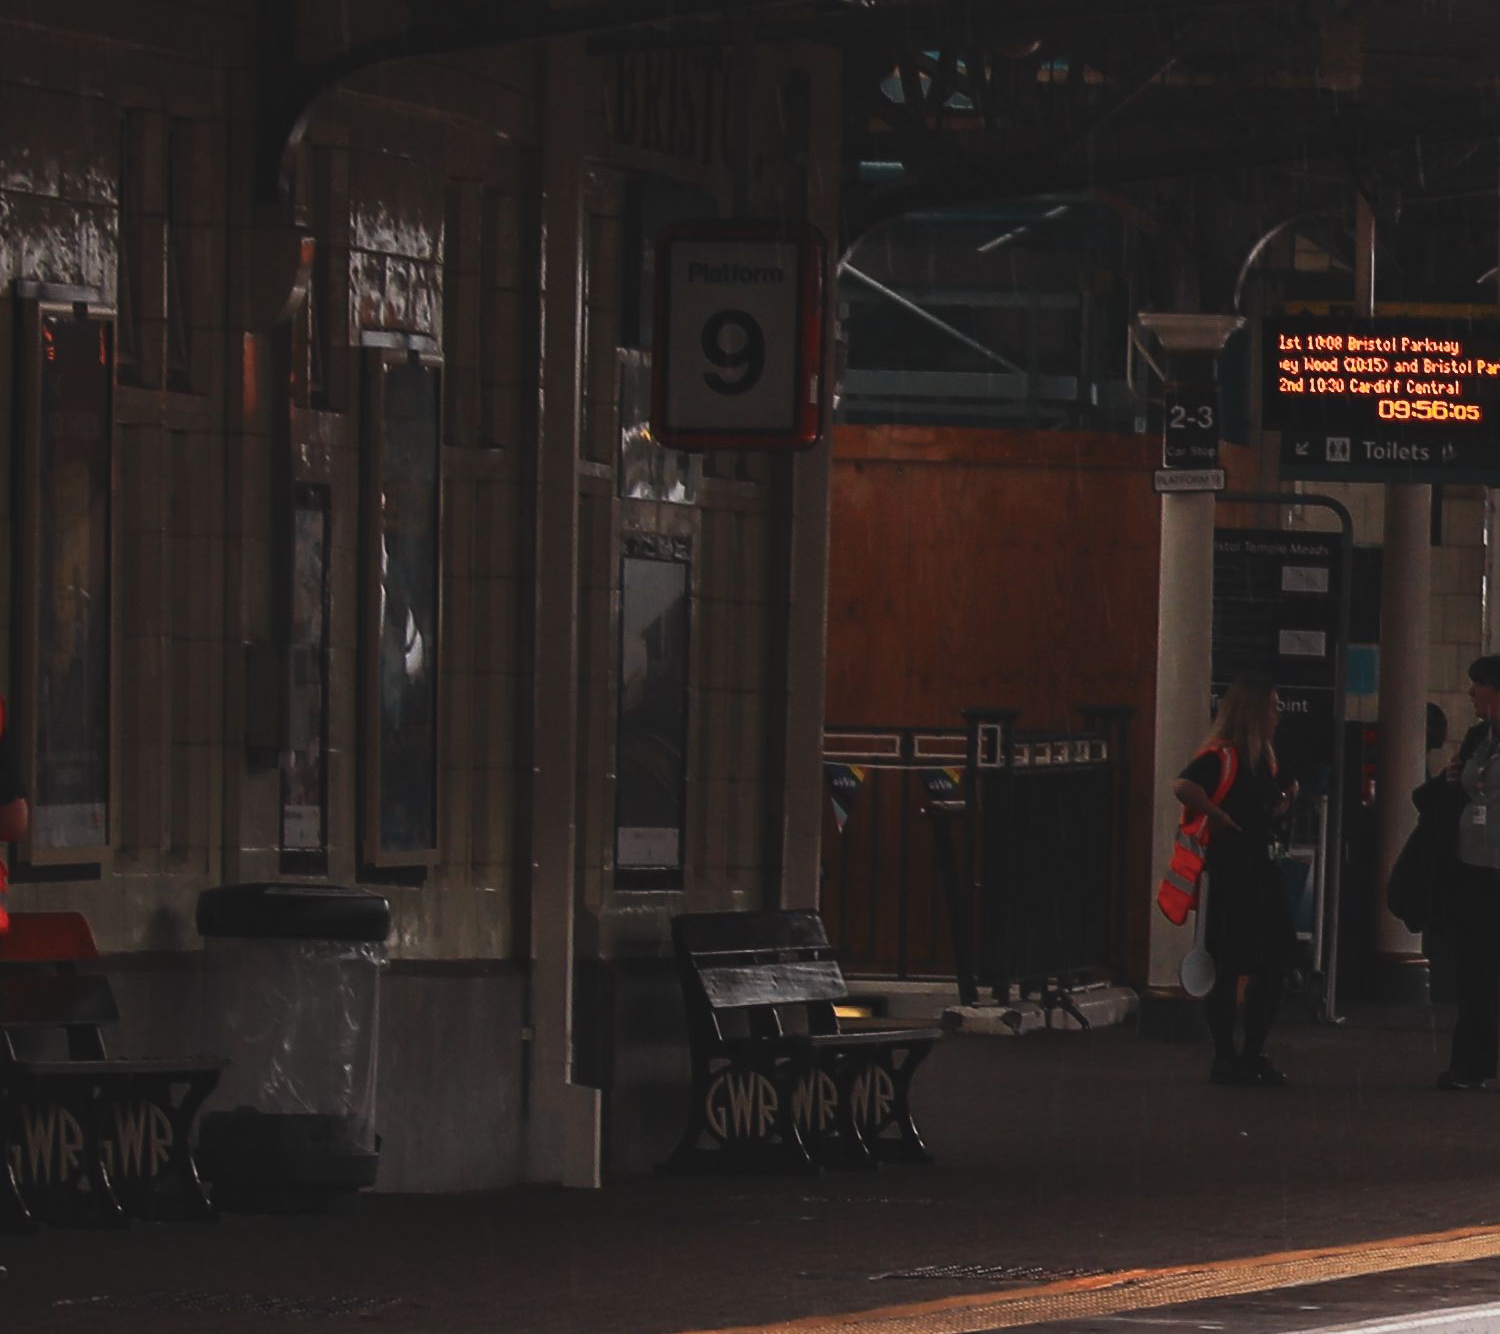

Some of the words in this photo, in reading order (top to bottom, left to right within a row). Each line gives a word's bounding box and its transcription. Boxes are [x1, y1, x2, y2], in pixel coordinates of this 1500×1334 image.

[687, 262, 784, 285] Platform
[701, 309, 766, 396] 9
[1279, 334, 1302, 351] 1st
[1307, 334, 1343, 351] 10:08
[1347, 335, 1397, 352] Bristol
[1401, 337, 1460, 357] Parkway
[1303, 356, 1339, 373] Wood
[1393, 358, 1419, 374] and
[1422, 358, 1473, 374] Bristol
[1279, 377, 1305, 393] 2nd
[1309, 376, 1345, 393] 10:30
[1349, 377, 1401, 394] Cardiff
[1406, 379, 1460, 396] Central
[1169, 405, 1213, 430] 2-3
[1378, 399, 1481, 421] 09:56:05
[1168, 447, 1187, 456] Car
[1191, 447, 1216, 459] Stop
[1362, 441, 1430, 461] Toilets
[1214, 541, 1241, 552] istol
[1245, 541, 1288, 555] Temple
[1290, 544, 1329, 555] Meads
[706, 1068, 779, 1140] GWR
